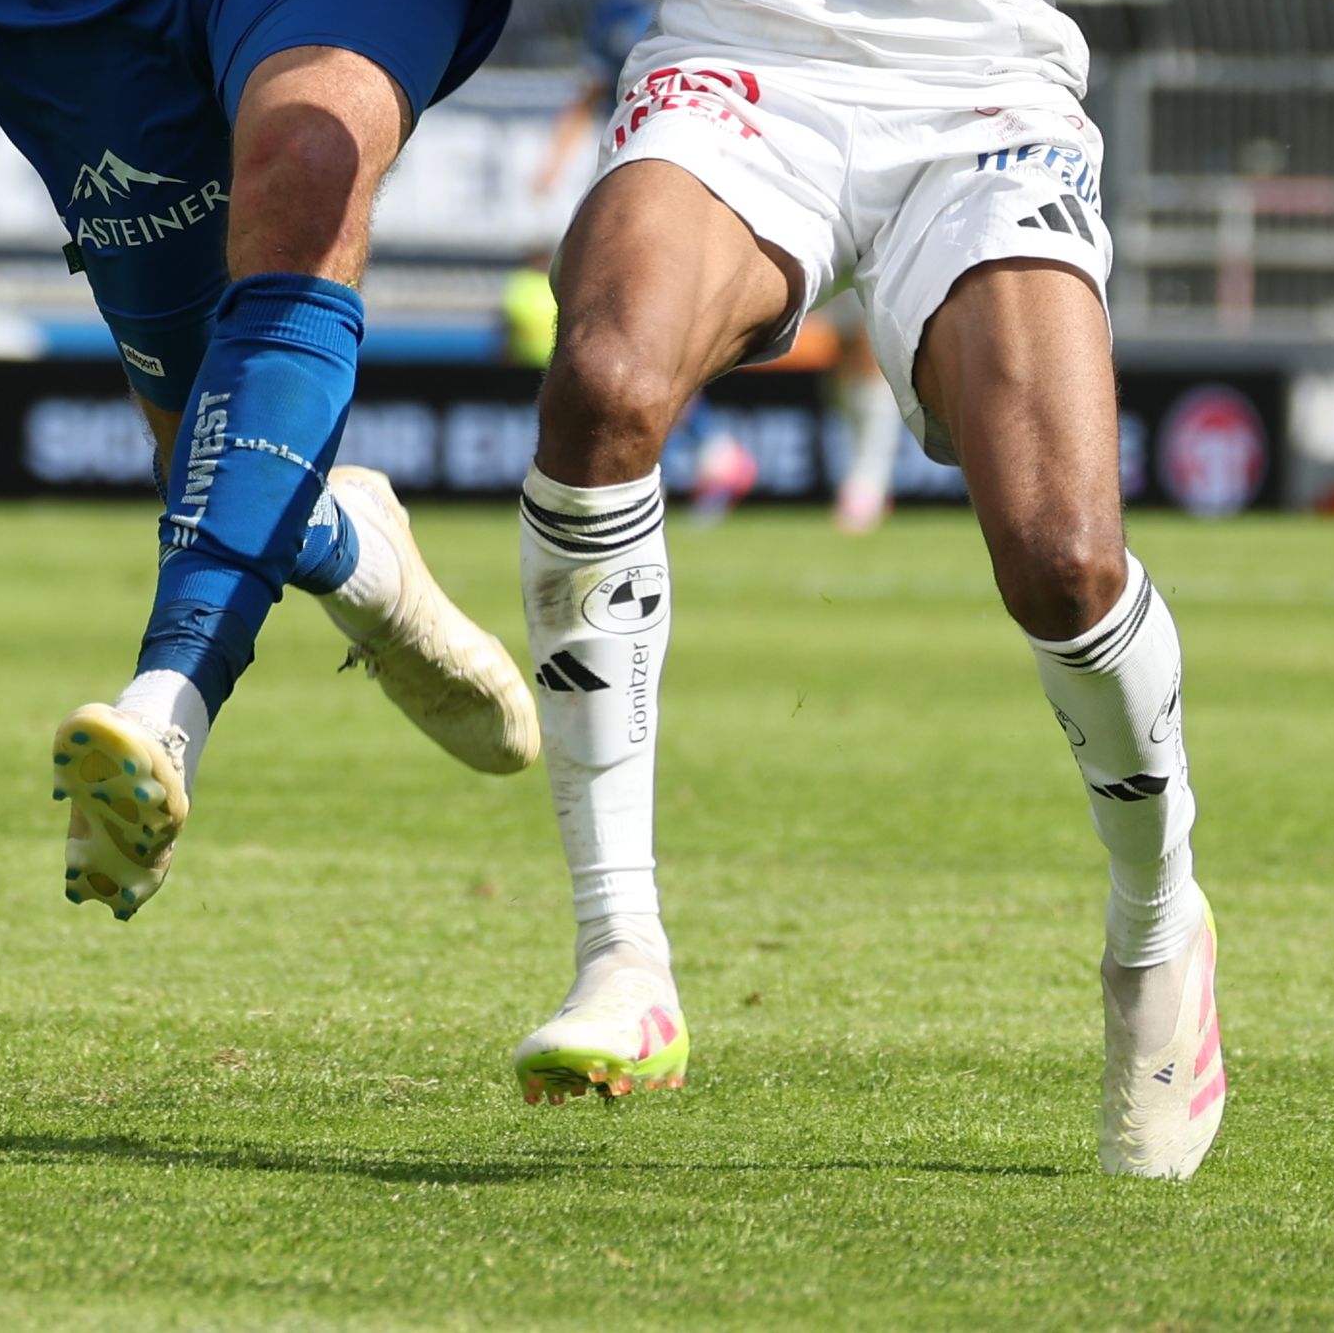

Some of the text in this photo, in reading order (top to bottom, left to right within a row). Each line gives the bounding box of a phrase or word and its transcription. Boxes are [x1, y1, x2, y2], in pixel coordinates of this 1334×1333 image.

[63, 179, 230, 250] ASTEINER
[169, 391, 231, 529] LIWEST
[599, 569, 665, 594] BMW
[626, 642, 650, 745] Gönitzer
